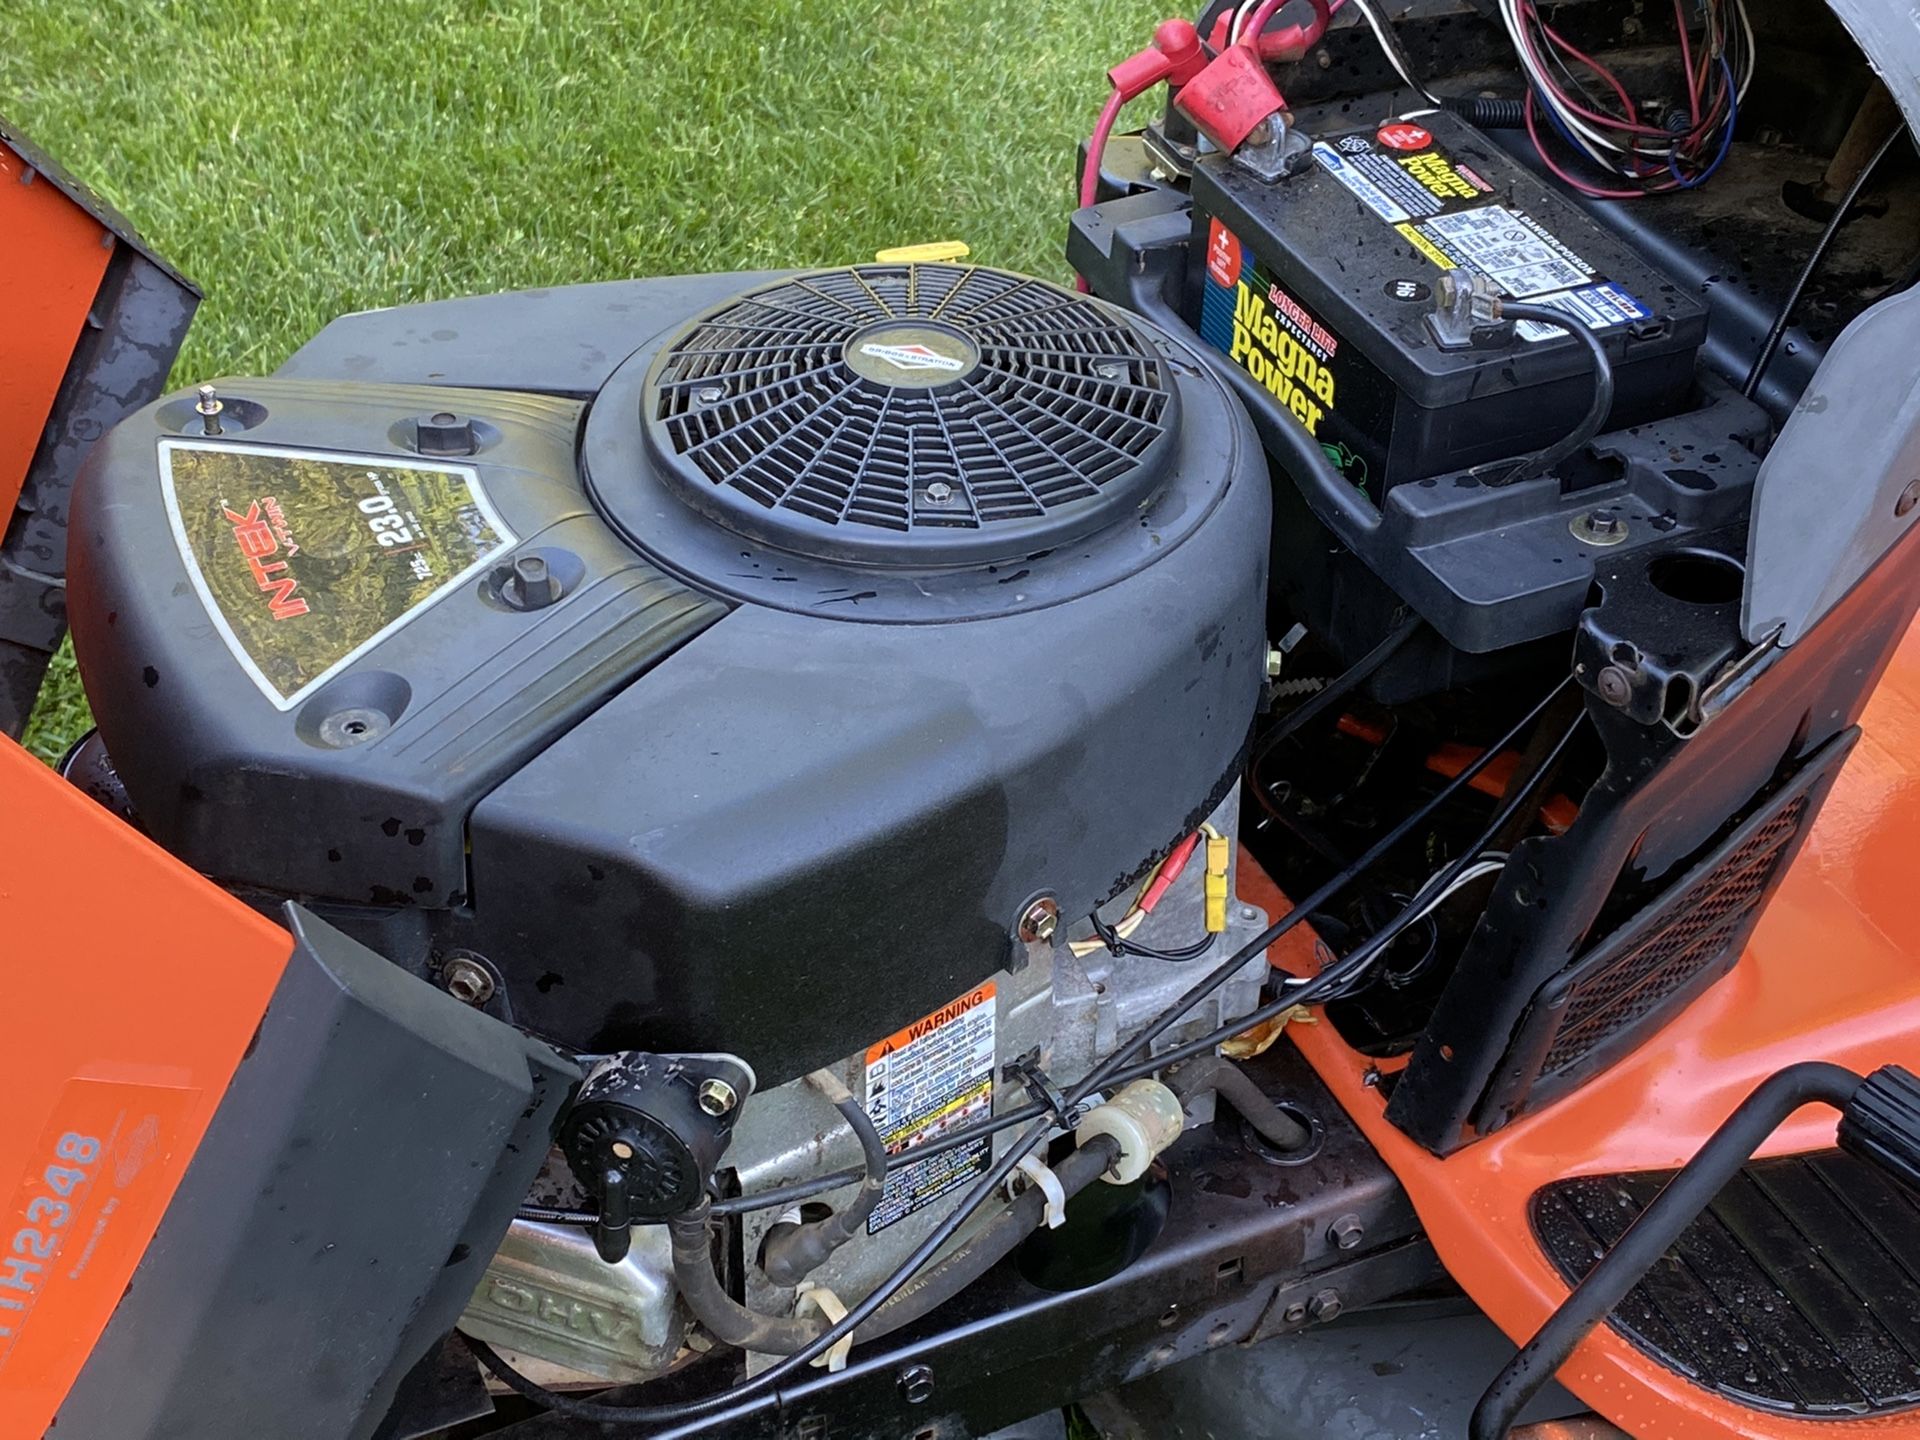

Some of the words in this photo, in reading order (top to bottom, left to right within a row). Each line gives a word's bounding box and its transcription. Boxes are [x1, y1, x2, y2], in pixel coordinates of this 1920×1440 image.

[1398, 155, 1456, 198] Power
[1417, 152, 1479, 199] Magna
[1233, 279, 1336, 410] Magna
[1268, 282, 1313, 333] LONGER
[1311, 319, 1338, 358] LIFE
[1274, 309, 1329, 364] EXPECTANCY
[1230, 319, 1325, 437] Power
[358, 495, 413, 547] 23.0
[909, 989, 982, 1042] WARNING
[487, 1278, 633, 1342] OHV
